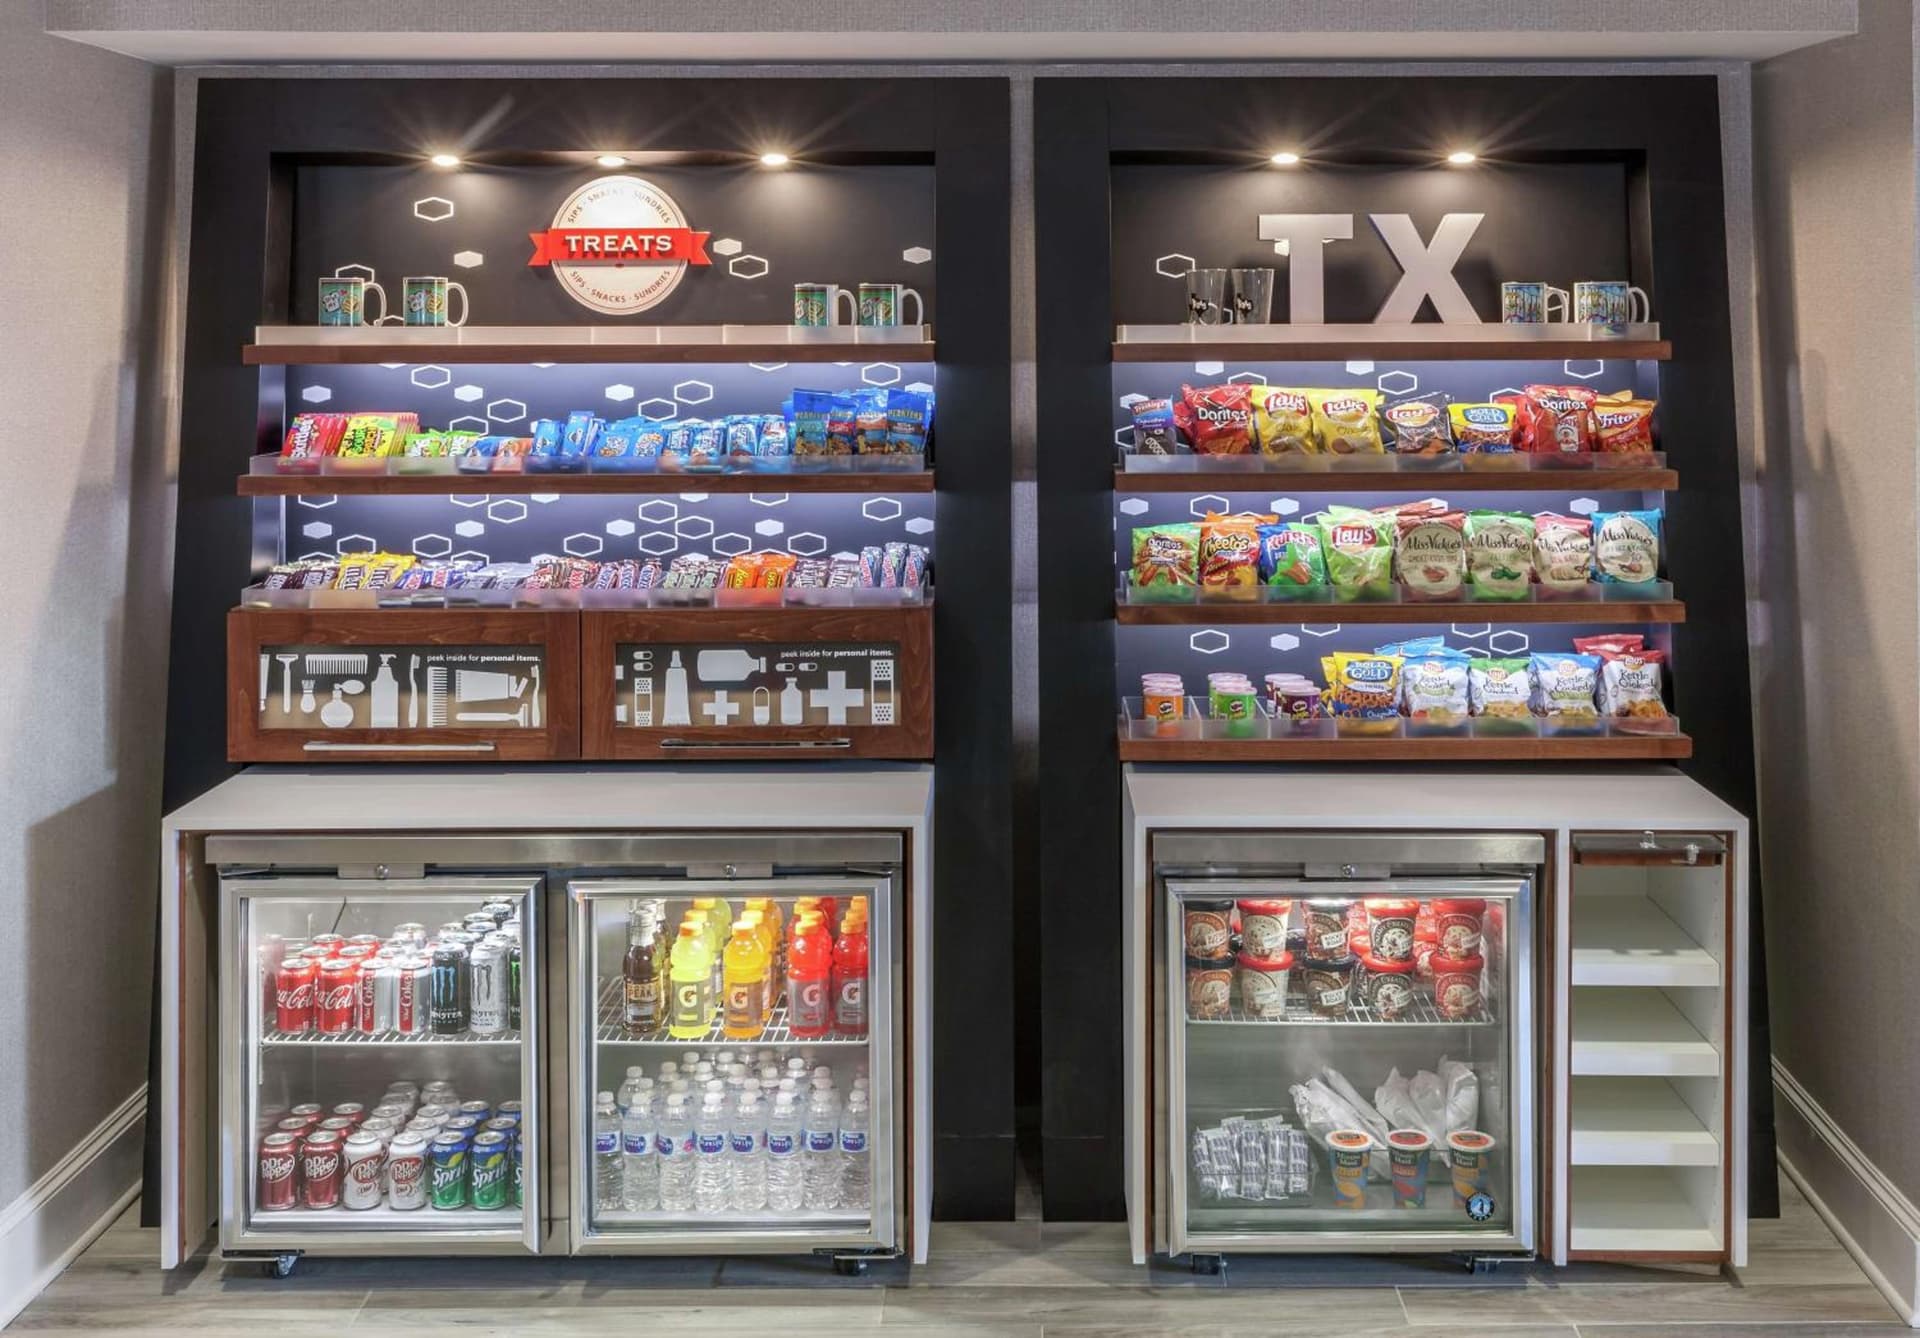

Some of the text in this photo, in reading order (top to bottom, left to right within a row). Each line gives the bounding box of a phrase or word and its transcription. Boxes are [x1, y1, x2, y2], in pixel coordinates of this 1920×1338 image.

[633, 191, 671, 224] SUNDRIES
[565, 235, 673, 252] TREATS
[1257, 213, 1486, 324] TX
[570, 270, 671, 303] SIPS SNACKS SUNDRIES
[1269, 392, 1306, 412] Lay's
[1539, 398, 1588, 410] Doritos
[1197, 407, 1248, 420] Doritos
[1468, 414, 1506, 423] GOLD
[1148, 538, 1182, 549] Doritos
[1204, 533, 1249, 555] Cheetos
[1333, 525, 1373, 546] Lay's
[1406, 532, 1461, 553] Miss Vickie's
[1476, 533, 1530, 553] Miss Vickie's
[1601, 527, 1625, 544] Miss
[427, 653, 541, 662] peek inside for personal items.
[799, 649, 821, 657] inside
[822, 649, 833, 657] for
[834, 649, 868, 658] personal
[869, 648, 894, 656] items.
[1351, 667, 1388, 679] GOLD
[1619, 678, 1656, 688] Cooked
[1620, 669, 1649, 680] Kettle
[363, 975, 375, 1006] Coke
[400, 975, 413, 1006] Coke
[679, 985, 697, 1008] G
[730, 987, 748, 1008] G
[802, 983, 821, 1006] G
[842, 982, 861, 1004] G
